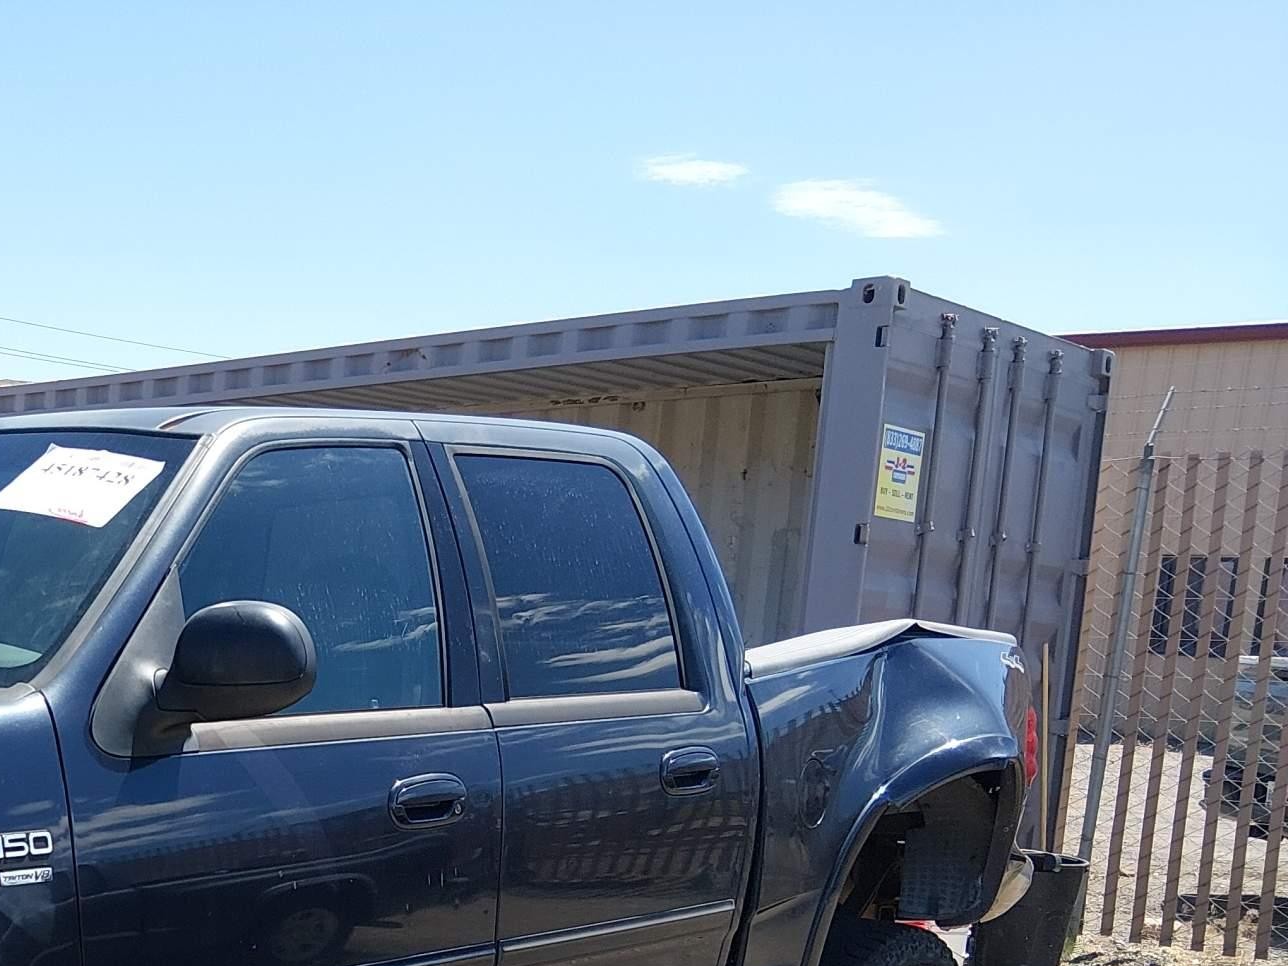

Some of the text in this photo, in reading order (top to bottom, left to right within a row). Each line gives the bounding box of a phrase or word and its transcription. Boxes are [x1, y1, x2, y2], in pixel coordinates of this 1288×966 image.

[880, 487, 888, 495] BUY
[3, 870, 51, 882] TRITON V8
